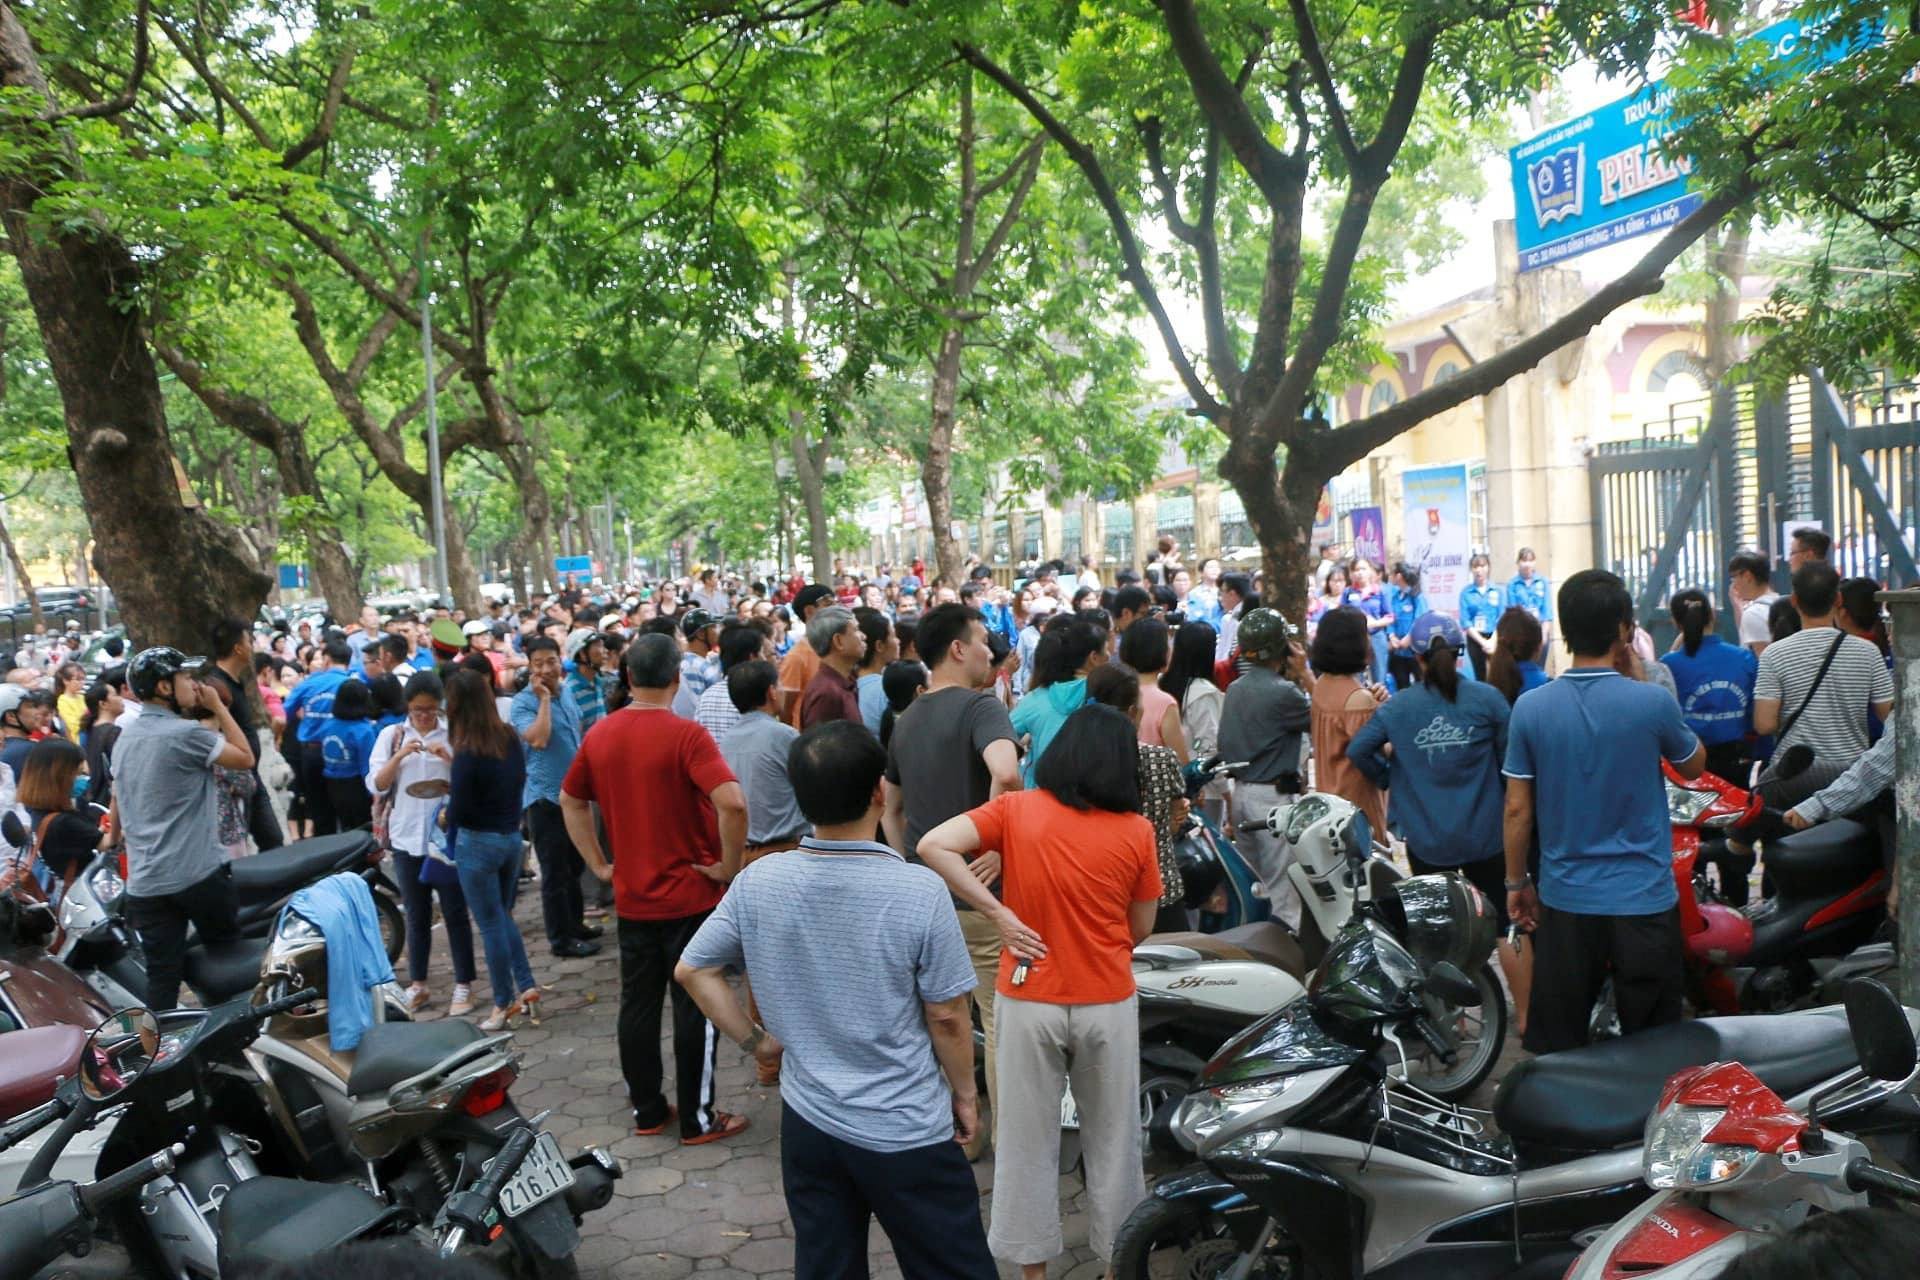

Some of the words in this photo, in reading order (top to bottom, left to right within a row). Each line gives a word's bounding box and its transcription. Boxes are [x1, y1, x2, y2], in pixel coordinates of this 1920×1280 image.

[1650, 207, 1662, 226] HÀ
[1662, 203, 1679, 223] NỘI
[1166, 975, 1208, 989] SH
[1203, 978, 1239, 986] mode
[503, 1161, 570, 1212] 216.11
